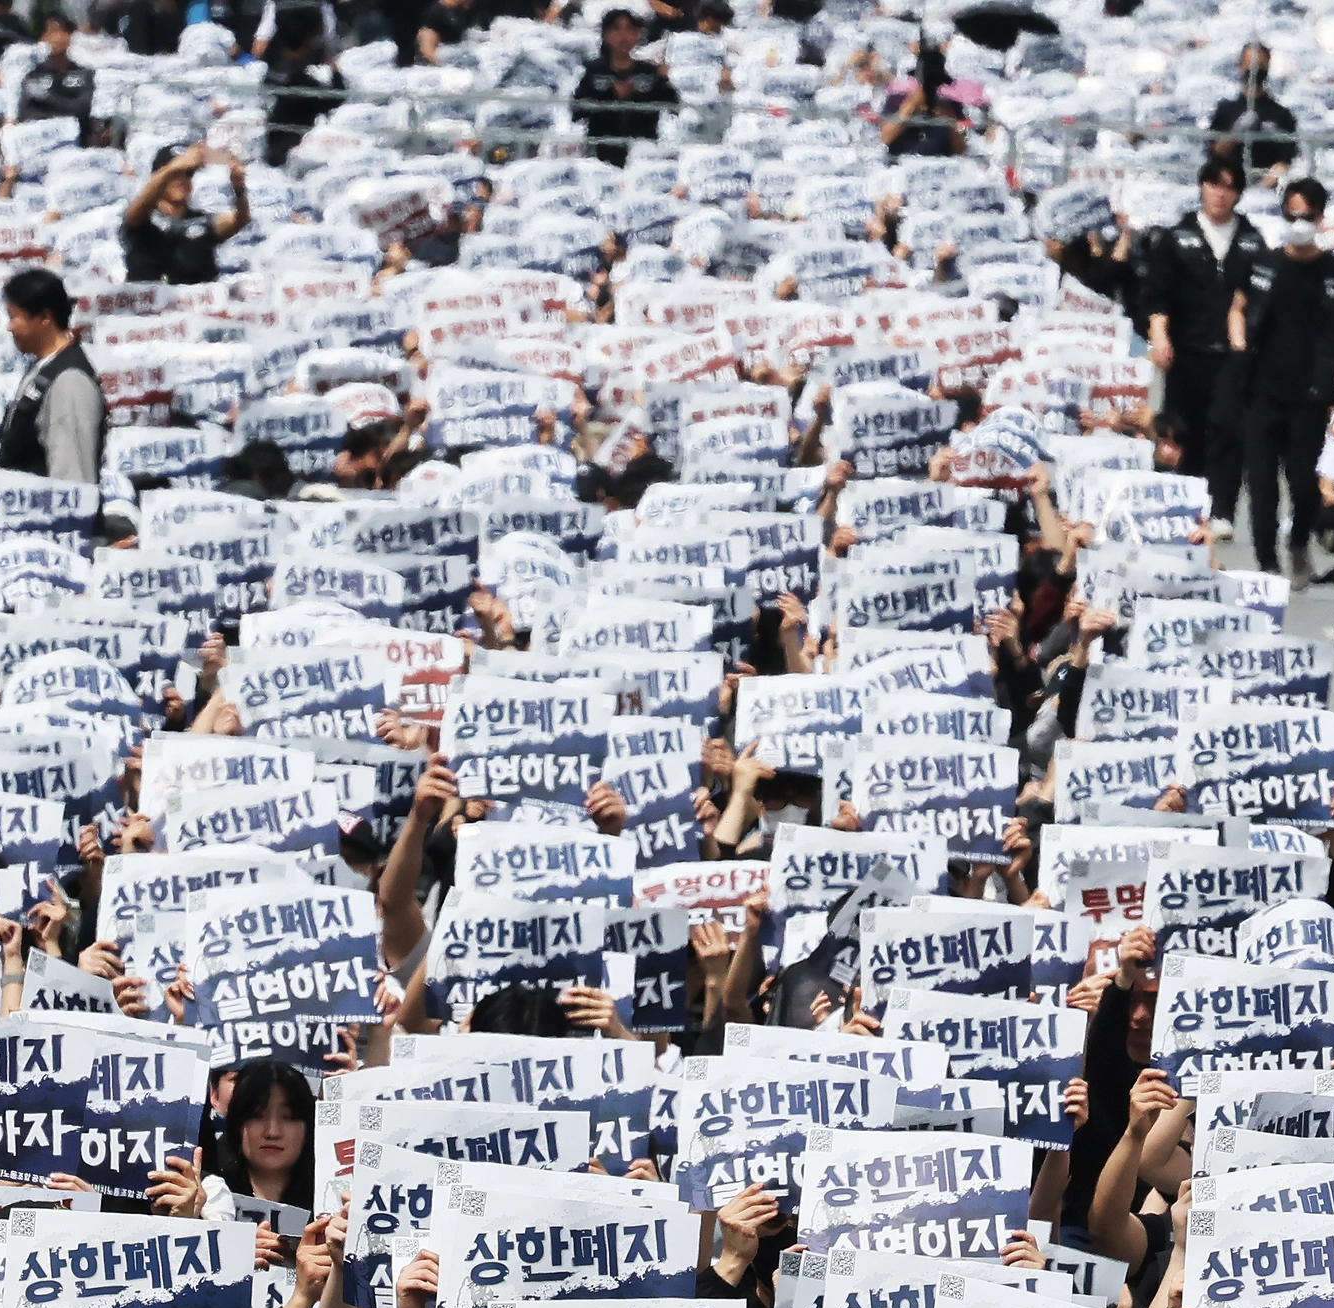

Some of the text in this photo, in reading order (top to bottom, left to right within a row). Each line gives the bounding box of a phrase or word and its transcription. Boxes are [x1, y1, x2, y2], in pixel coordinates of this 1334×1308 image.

[100, 565, 202, 598] 상한폐지
[285, 567, 388, 599] 상한폐지
[845, 584, 957, 627] 상한폐지
[240, 660, 366, 706] 상한폐지
[453, 698, 589, 742] 상한폐지
[1190, 715, 1323, 767] 상한폐지
[458, 756, 601, 798] 실현하자
[866, 753, 997, 795] 상한폐지
[1197, 769, 1332, 818] 실현하자
[179, 791, 314, 849] 상한폐지
[469, 845, 613, 887] 상한폐지
[1157, 861, 1305, 907] 상한폐지
[200, 897, 354, 957] 상한폐지
[441, 913, 584, 960] 상한폐지
[867, 928, 1014, 985] 상한폐지
[212, 960, 373, 1021] 실현하자
[1169, 978, 1331, 1031] 상한폐지
[695, 1080, 870, 1137] 상한폐지
[819, 1142, 1003, 1205] 상한폐지
[20, 1227, 221, 1302] 상한폐지
[469, 1221, 666, 1284] 상한폐지
